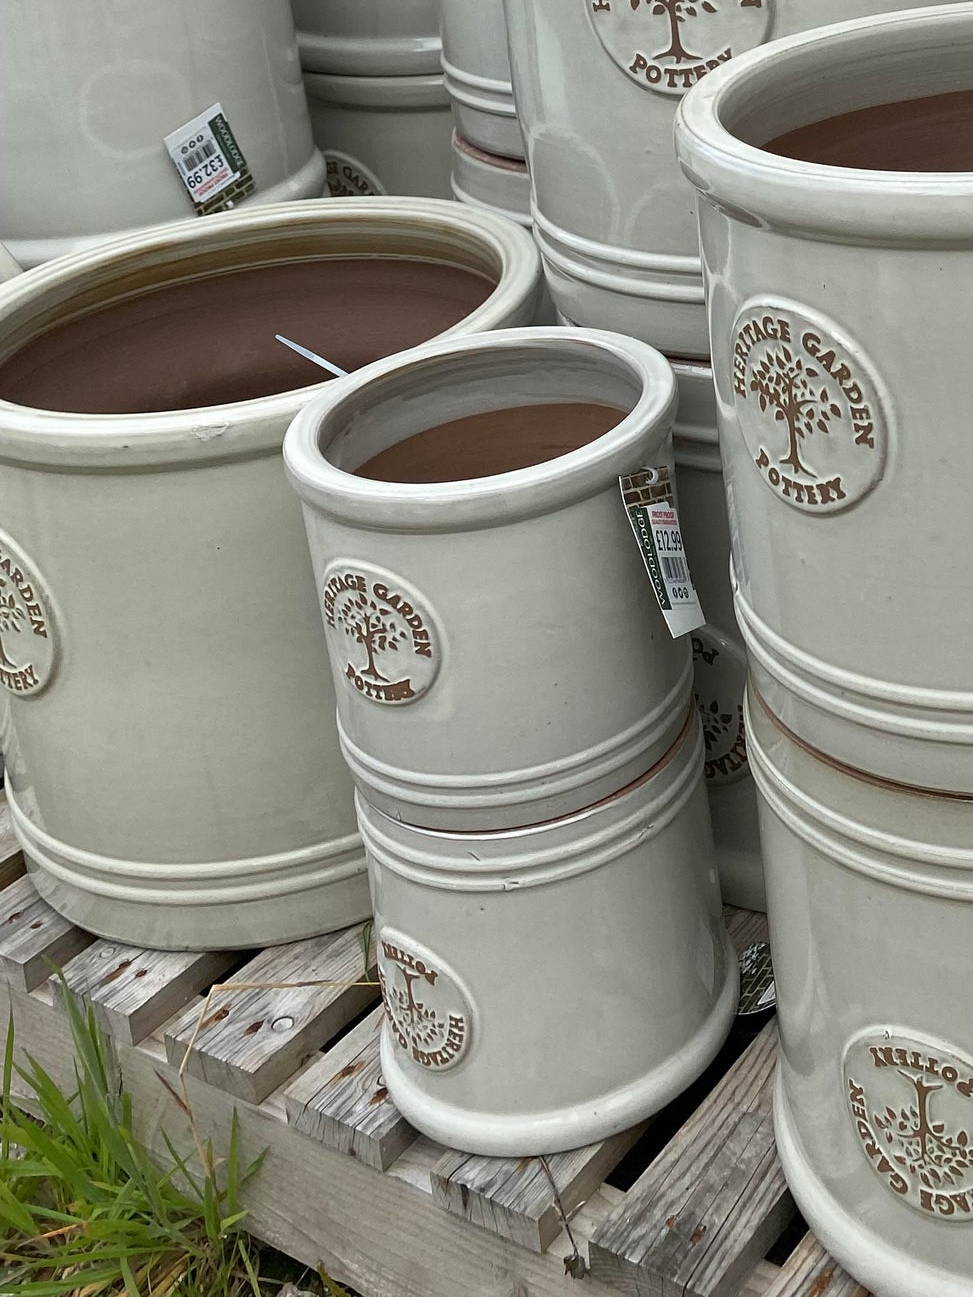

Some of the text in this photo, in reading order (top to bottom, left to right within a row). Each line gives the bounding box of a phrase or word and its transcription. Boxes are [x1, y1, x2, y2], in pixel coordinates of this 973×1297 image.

[187, 154, 224, 189] £32.99
[734, 316, 875, 449] HERITAGE GARDEN
[755, 448, 847, 505] POTTERY
[656, 530, 682, 551] £12.99
[0, 557, 48, 639] ARDEN
[324, 573, 432, 658] HERITAGE GARDEN
[0, 664, 39, 691] TTERY
[412, 1014, 464, 1067] HERITAGE
[849, 1078, 909, 1195] GARDEN
